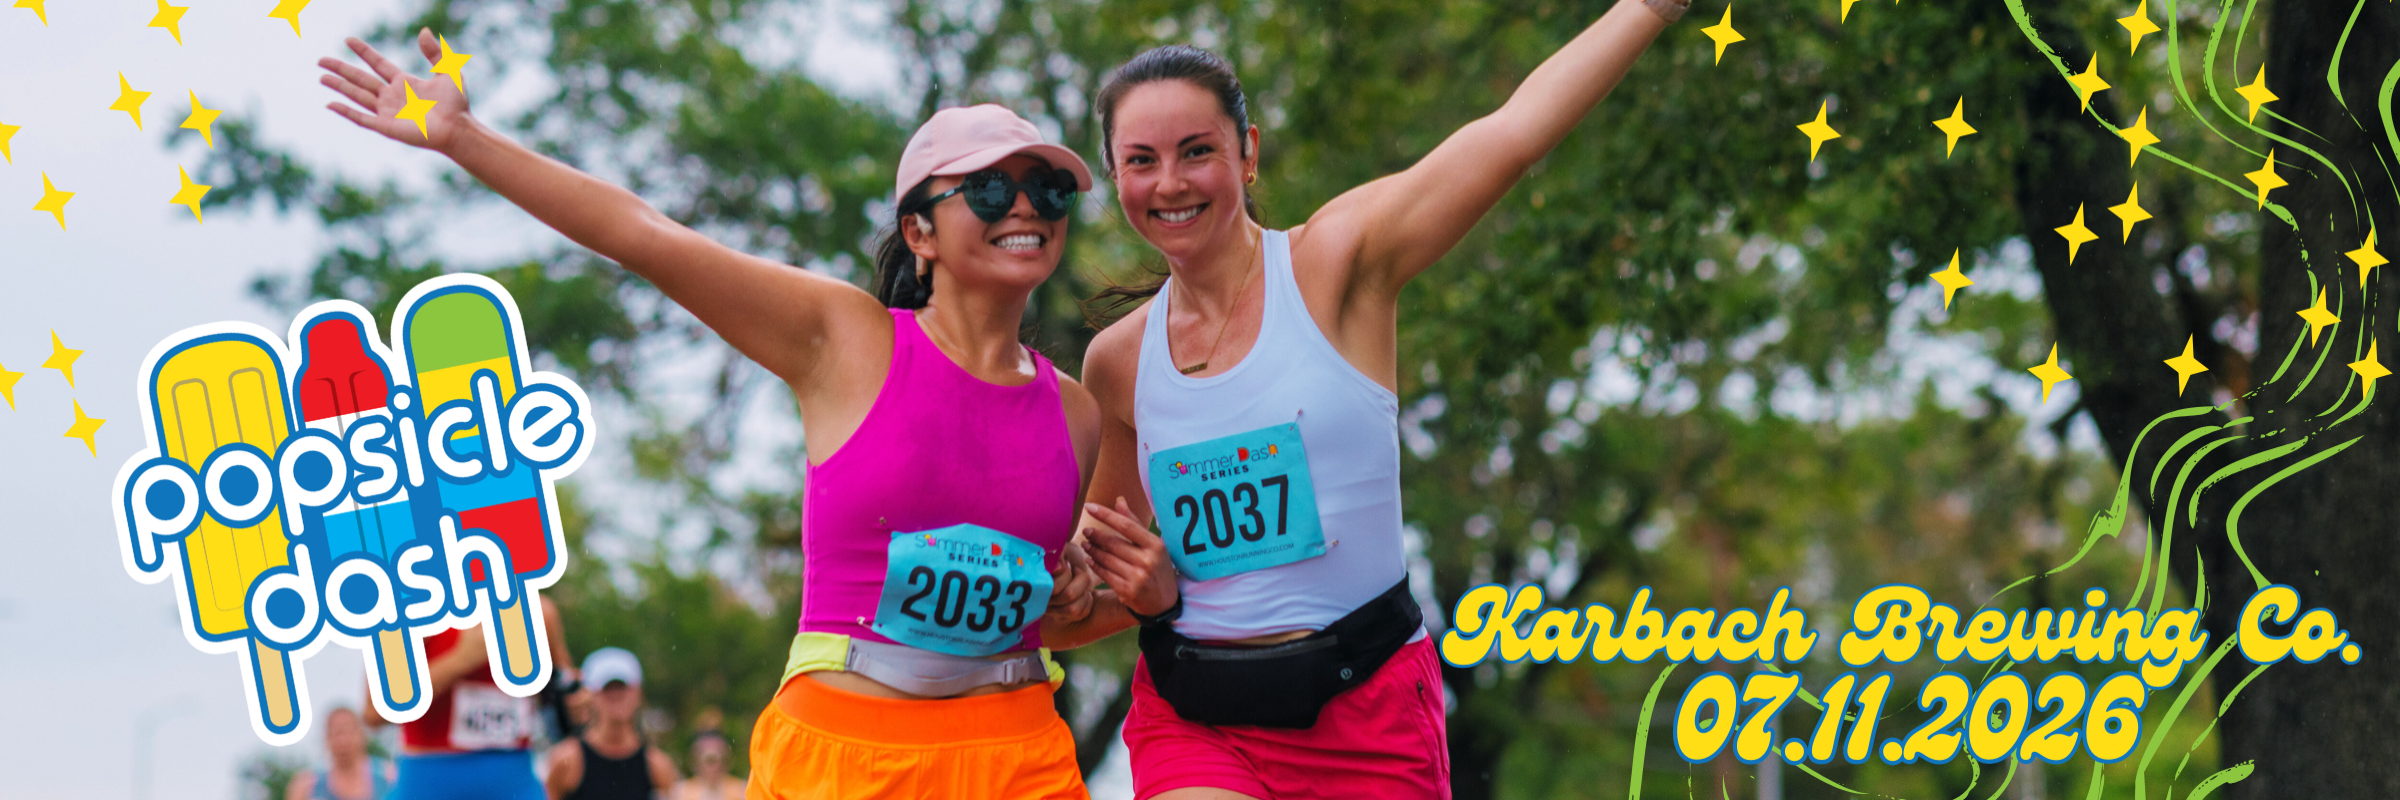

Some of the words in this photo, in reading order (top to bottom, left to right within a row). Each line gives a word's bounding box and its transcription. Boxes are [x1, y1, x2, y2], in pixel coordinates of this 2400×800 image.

[1169, 454, 1235, 479] Summer
[1237, 443, 1279, 463] Dash
[1201, 464, 1250, 482] SERIES
[1174, 474, 1289, 555] 2037
[914, 534, 988, 556] Summer
[1197, 543, 1294, 568] WWW.HOUSTONRUNNINGCO.COM
[948, 552, 999, 568] SERIES
[900, 565, 1032, 634] 2033
